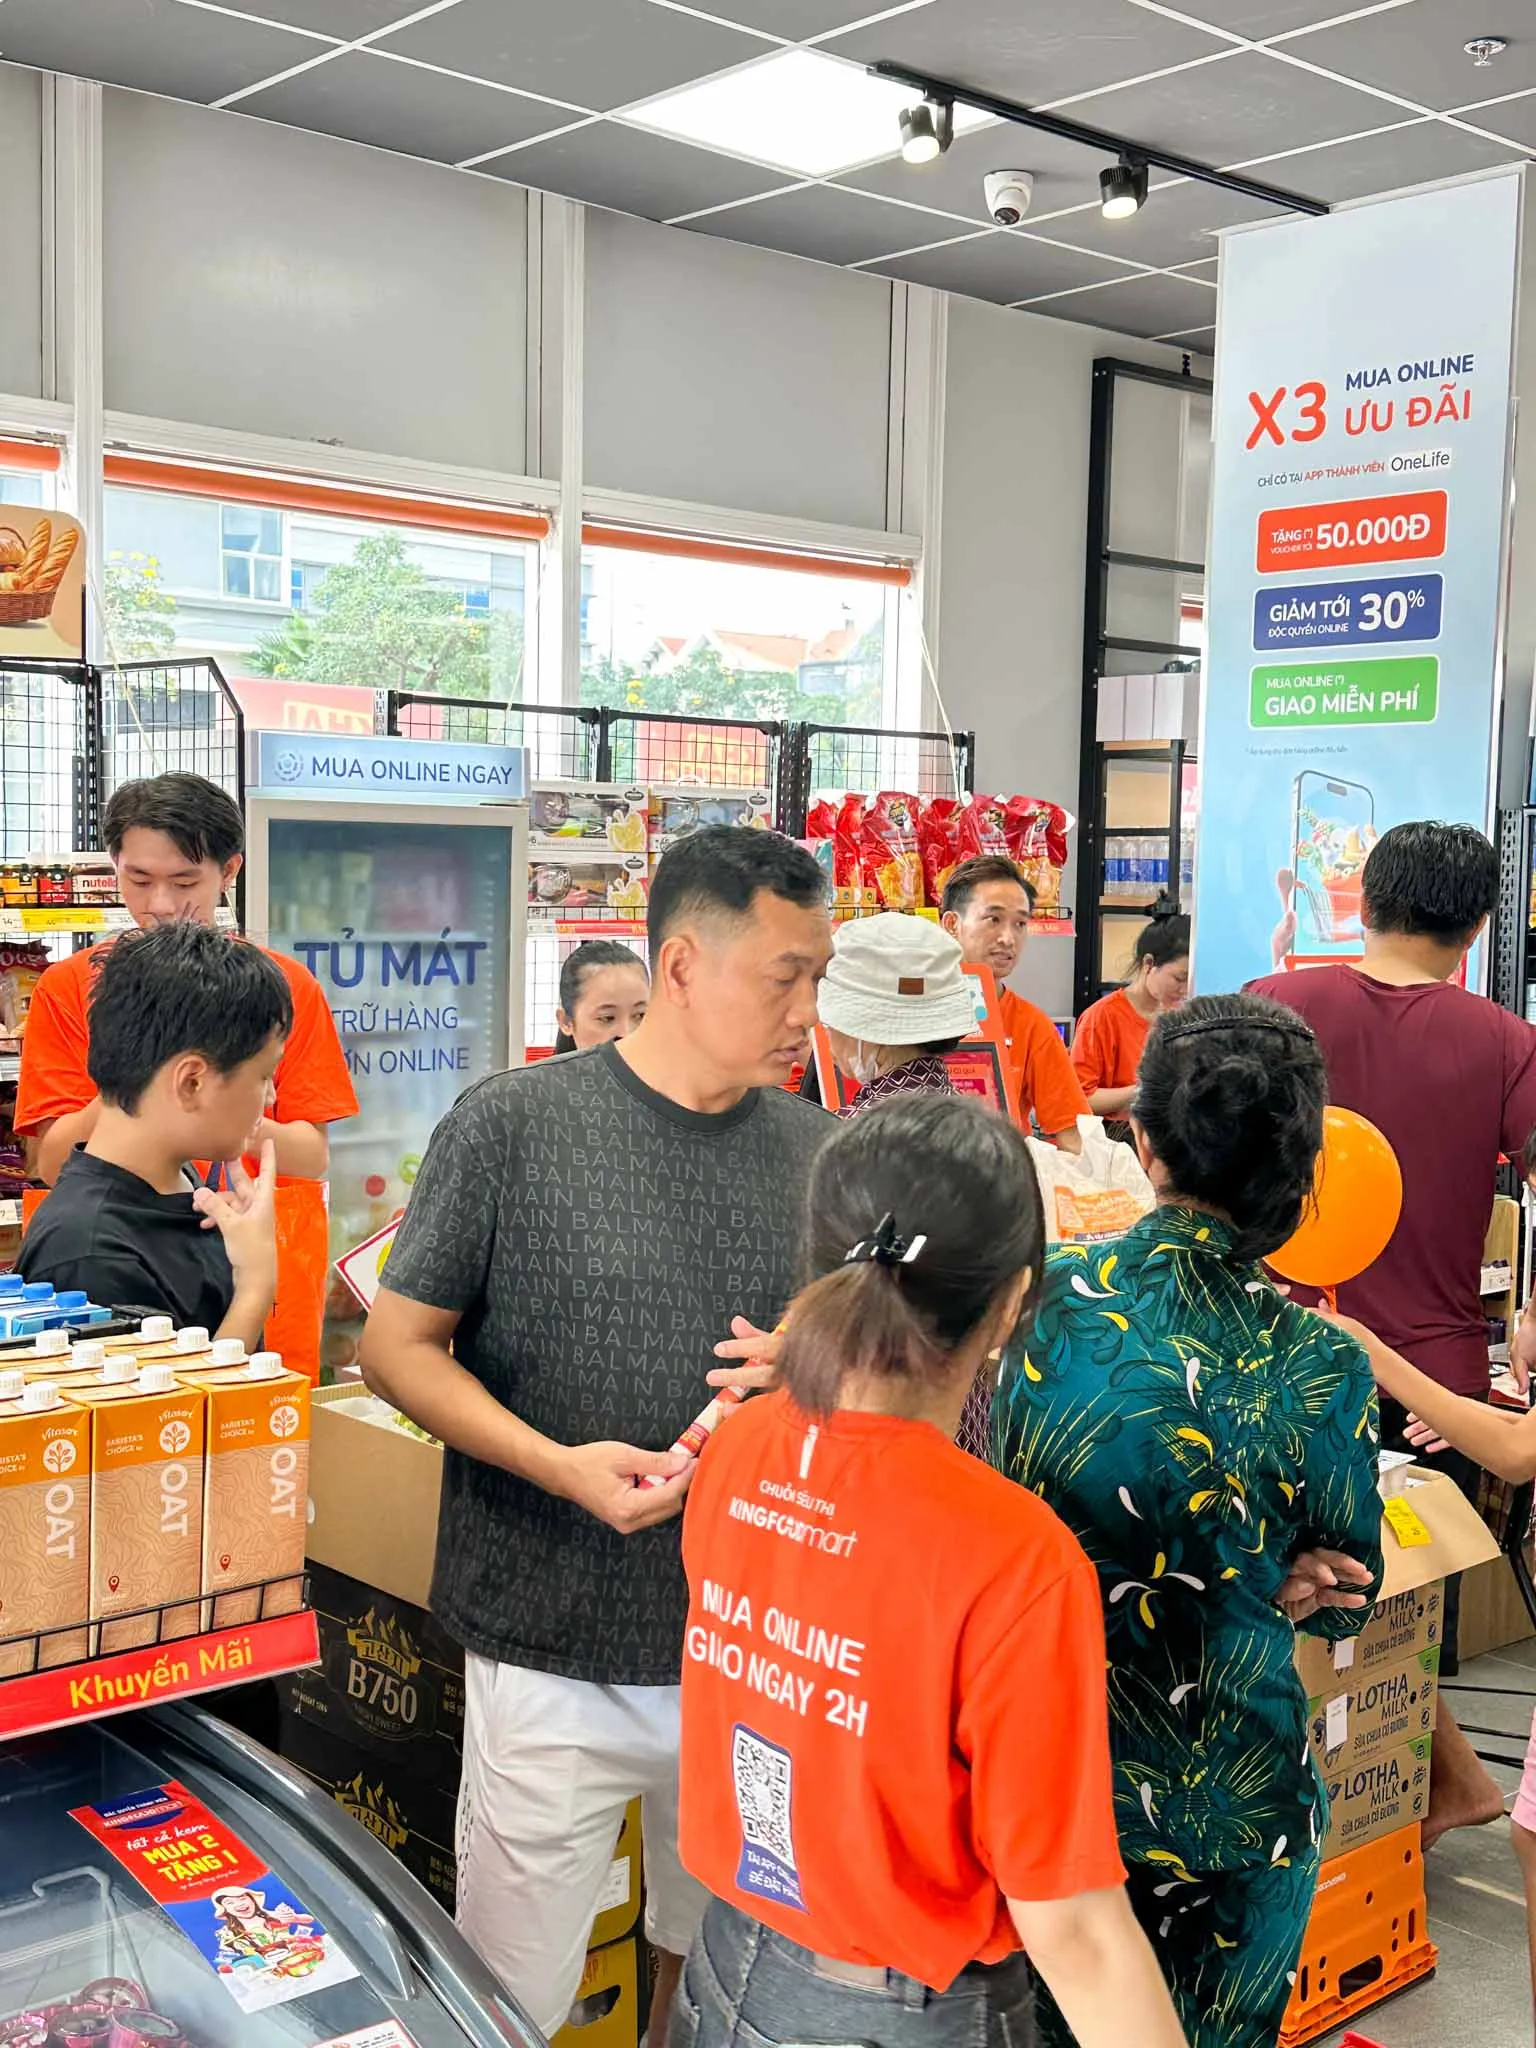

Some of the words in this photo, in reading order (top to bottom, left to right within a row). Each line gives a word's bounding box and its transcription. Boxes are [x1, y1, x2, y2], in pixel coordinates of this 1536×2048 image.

[1346, 368, 1391, 391] MUA
[1397, 354, 1474, 382] ONLINE
[1246, 381, 1327, 449] X3
[1345, 399, 1394, 436] ƯU
[1405, 382, 1471, 428] ĐÃI
[1304, 469, 1324, 482] APP
[1390, 451, 1451, 472] OneLife
[1315, 512, 1431, 551] 50.000Đ
[1269, 598, 1316, 623] GIẢM
[1320, 592, 1350, 619] TỚI
[1358, 588, 1425, 631] 30%
[1317, 621, 1349, 635] ONLINE
[1266, 676, 1292, 689] MUA
[1293, 674, 1333, 688] ONLINE
[1265, 694, 1316, 717] GIAO
[1322, 685, 1375, 714] MIỄN
[1380, 683, 1421, 712] PHÍ
[311, 756, 364, 779] MUA
[371, 760, 451, 783] ONLINE
[456, 763, 513, 786] NGAY
[293, 927, 365, 988] TỦ
[381, 927, 488, 987] MÁT
[385, 1001, 459, 1033] HÀNG
[379, 1047, 471, 1075] ONLINE
[523, 1097, 657, 1135] BALMAIN
[586, 1128, 718, 1164] BALMAIN
[525, 1162, 660, 1196] BALMAIN
[572, 1147, 705, 1184] BALMAIN
[588, 1191, 719, 1228] BALMAIN
[527, 1231, 662, 1261] BALMAIN
[572, 1210, 704, 1246] BALMAIN
[587, 1256, 715, 1291] BALMAIN
[572, 1278, 704, 1310] BALMAIN
[529, 1297, 660, 1330] BALMAIN
[538, 1359, 655, 1397] BALMAIN
[573, 1345, 702, 1378] BALMAIN
[160, 1462, 189, 1537] OAT
[270, 1447, 297, 1519] OAT
[45, 1483, 75, 1559] OAT
[1389, 1608, 1416, 1633] MILK
[763, 1606, 866, 1678] ONLINE
[69, 1654, 190, 1709] Khuyến
[199, 1637, 254, 1677] Mãi
[347, 1657, 418, 1724] B750
[747, 1651, 815, 1718] NGAY
[824, 1687, 868, 1738] 2H
[1356, 1673, 1409, 1714] LOTHA
[1381, 1695, 1409, 1721] MILK
[1344, 1759, 1401, 1801] LOTHA
[1370, 1780, 1401, 1808] MILK
[141, 1839, 199, 1866] MUA
[197, 1833, 220, 1850] 2
[156, 1853, 224, 1883] TẶNG
[221, 1848, 239, 1865] 1
